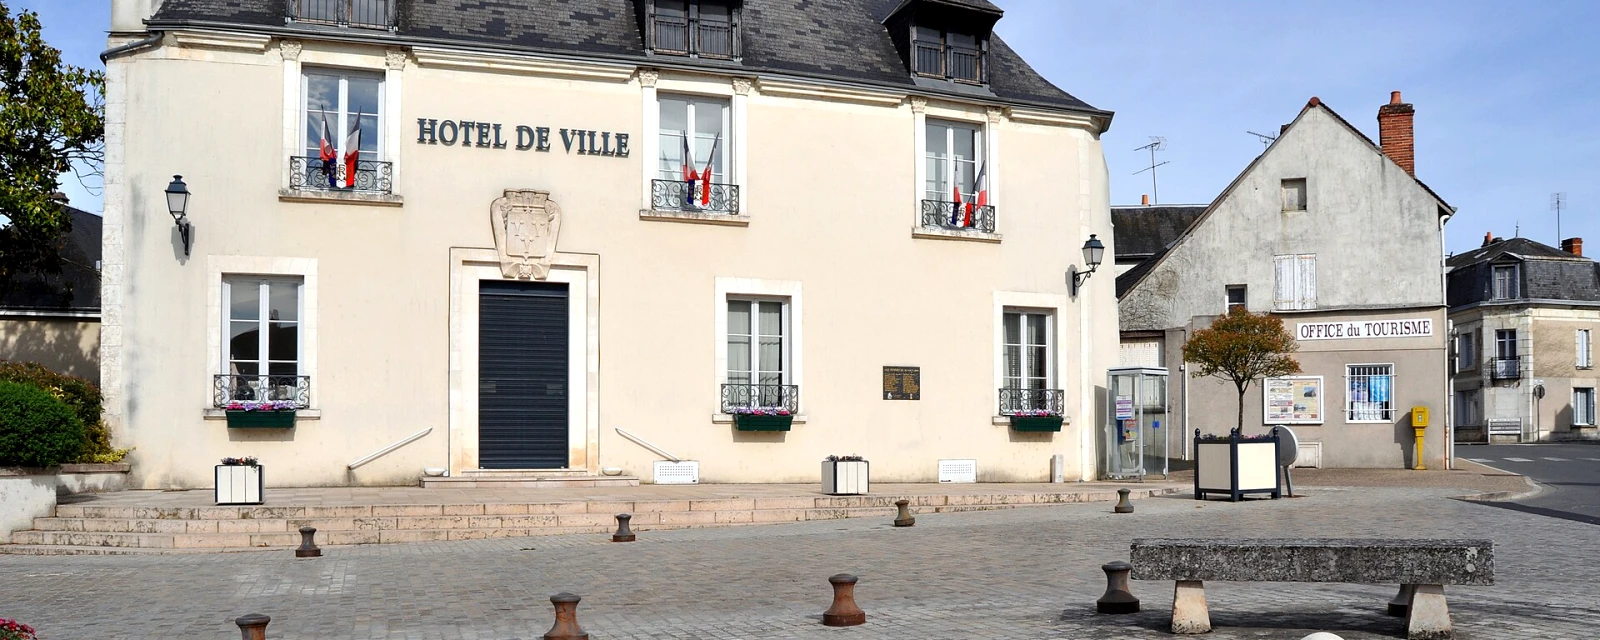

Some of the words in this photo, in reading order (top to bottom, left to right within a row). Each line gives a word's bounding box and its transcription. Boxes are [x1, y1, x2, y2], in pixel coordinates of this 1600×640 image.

[417, 118, 507, 149] HOTEL
[515, 125, 550, 152] DE
[559, 128, 630, 158] VILLE
[1300, 324, 1343, 338] OFFICE
[1347, 323, 1361, 337] du
[1365, 320, 1430, 336] TOURISME
